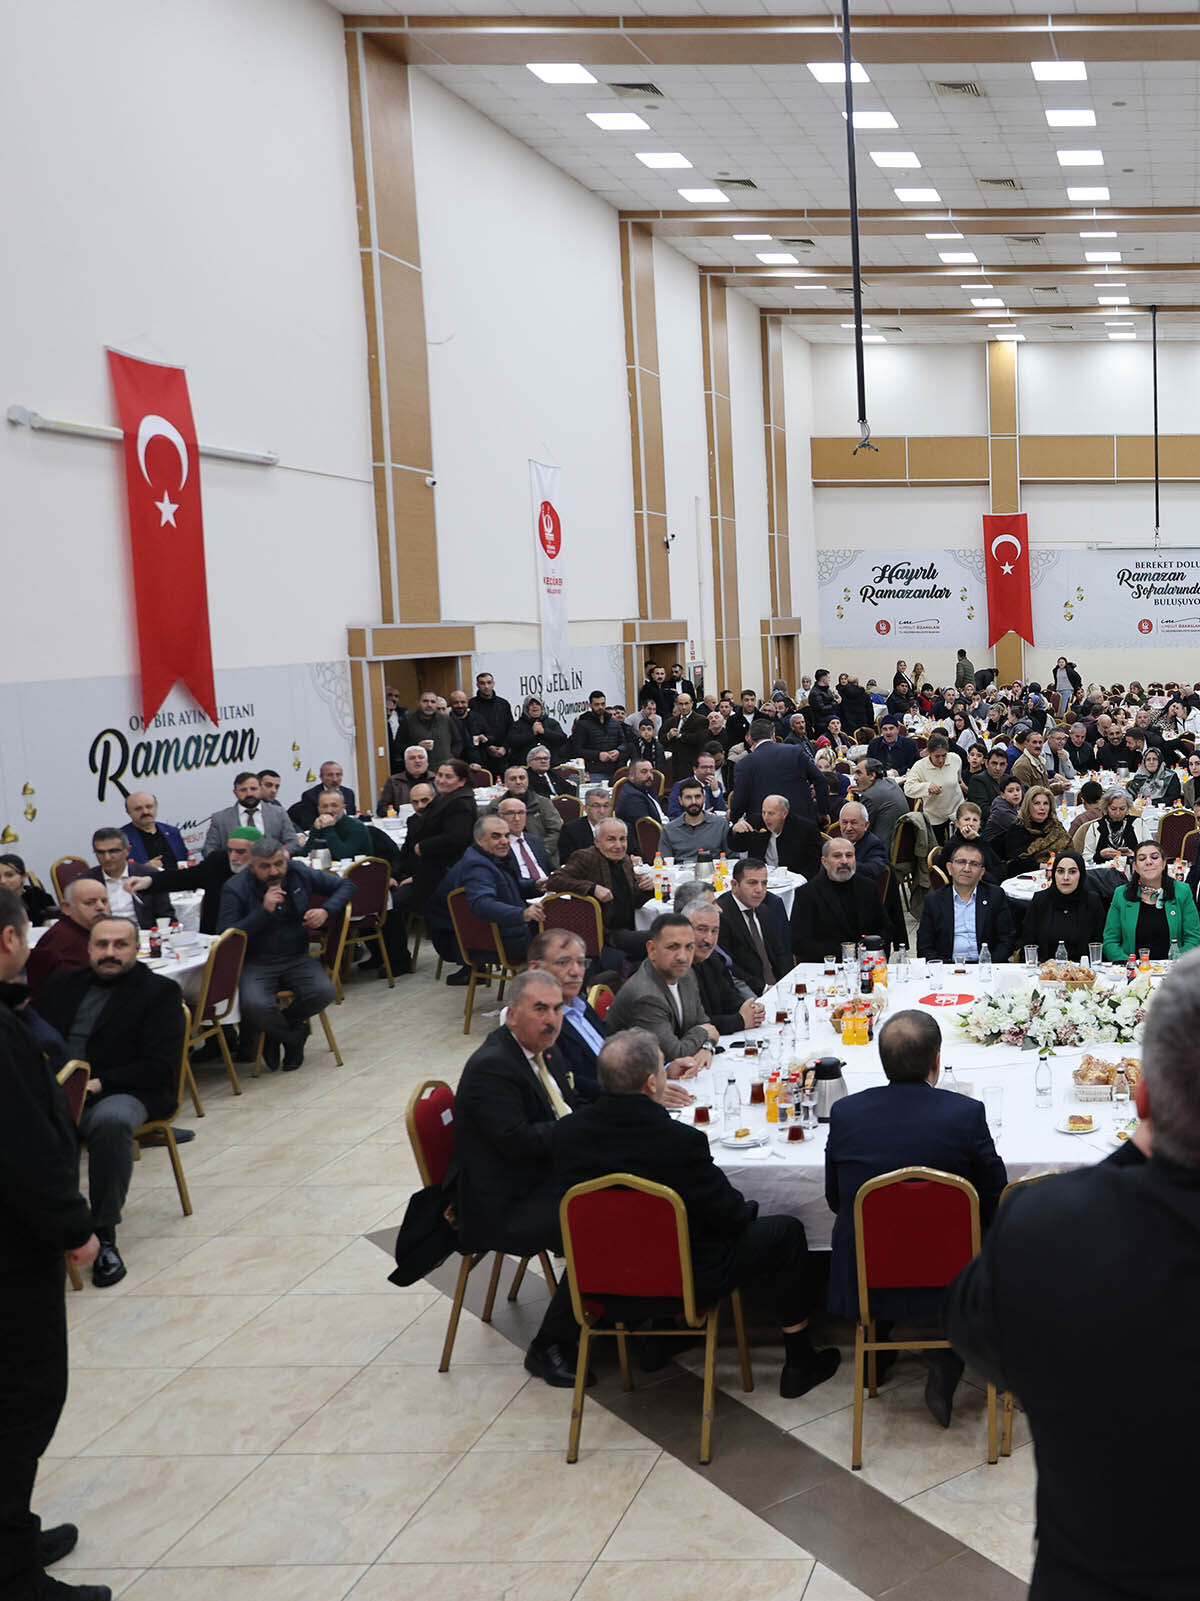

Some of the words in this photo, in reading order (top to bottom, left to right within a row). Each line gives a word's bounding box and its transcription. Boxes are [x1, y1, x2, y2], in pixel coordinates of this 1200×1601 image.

[872, 561, 939, 586] Hayırlı
[1135, 561, 1174, 569] BEREKET
[1117, 568, 1187, 589] Ramazan
[859, 583, 952, 606] Ramazanlar
[520, 674, 543, 698] HOŞ
[155, 710, 177, 728] BİR
[217, 703, 255, 721] ULTANI
[89, 728, 260, 802] Ramazan
